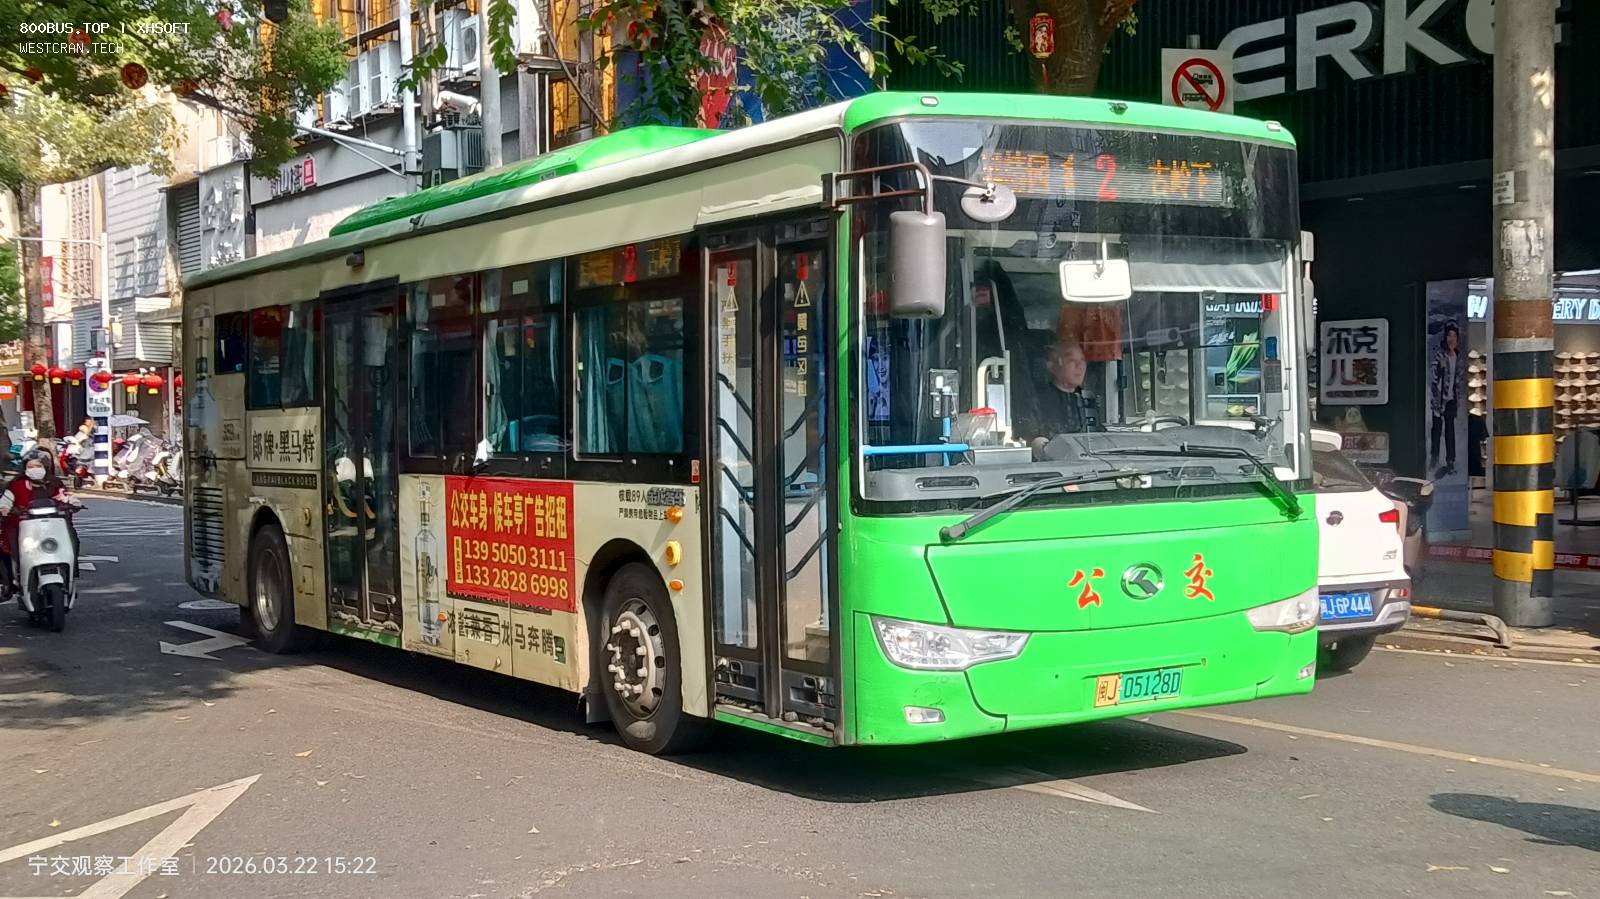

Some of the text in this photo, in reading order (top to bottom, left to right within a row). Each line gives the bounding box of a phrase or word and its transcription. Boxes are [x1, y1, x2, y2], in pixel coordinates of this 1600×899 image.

[1095, 153, 1118, 200] 2
[623, 244, 637, 283] 2
[1326, 325, 1378, 354] 尔克
[464, 539, 489, 561] 139
[491, 542, 527, 566] 5050
[529, 547, 568, 572] 3111
[465, 564, 569, 600] 133 2828 6998
[1068, 553, 1215, 609] 公 交
